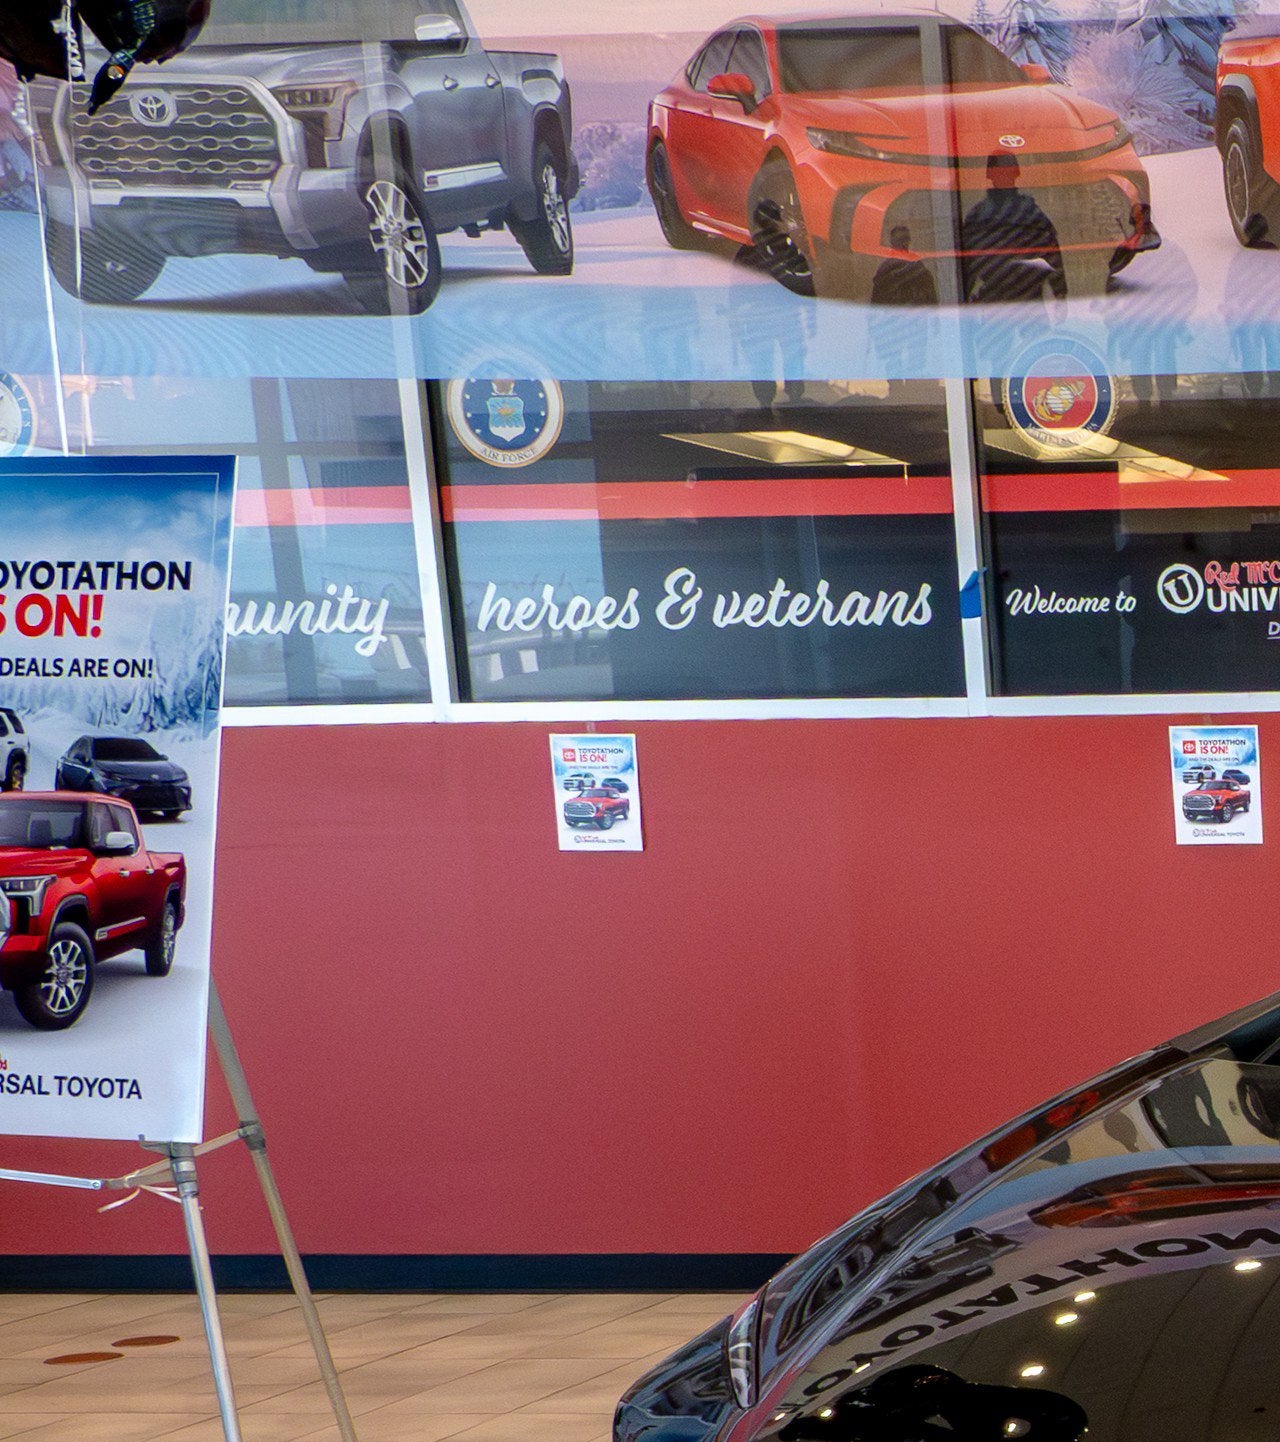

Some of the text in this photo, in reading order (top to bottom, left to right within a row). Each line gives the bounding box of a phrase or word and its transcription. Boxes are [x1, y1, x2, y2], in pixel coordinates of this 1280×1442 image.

[480, 447, 499, 462] AIR
[1205, 561, 1239, 593] Red
[476, 566, 933, 633] heroes & veterans
[1005, 584, 1138, 617] Welcome to
[15, 593, 104, 639] ON!
[68, 658, 109, 678] ARE
[113, 658, 155, 679] ON!
[1200, 745, 1228, 754] IS ON!
[0, 1073, 143, 1100] SAL TOYOTA
